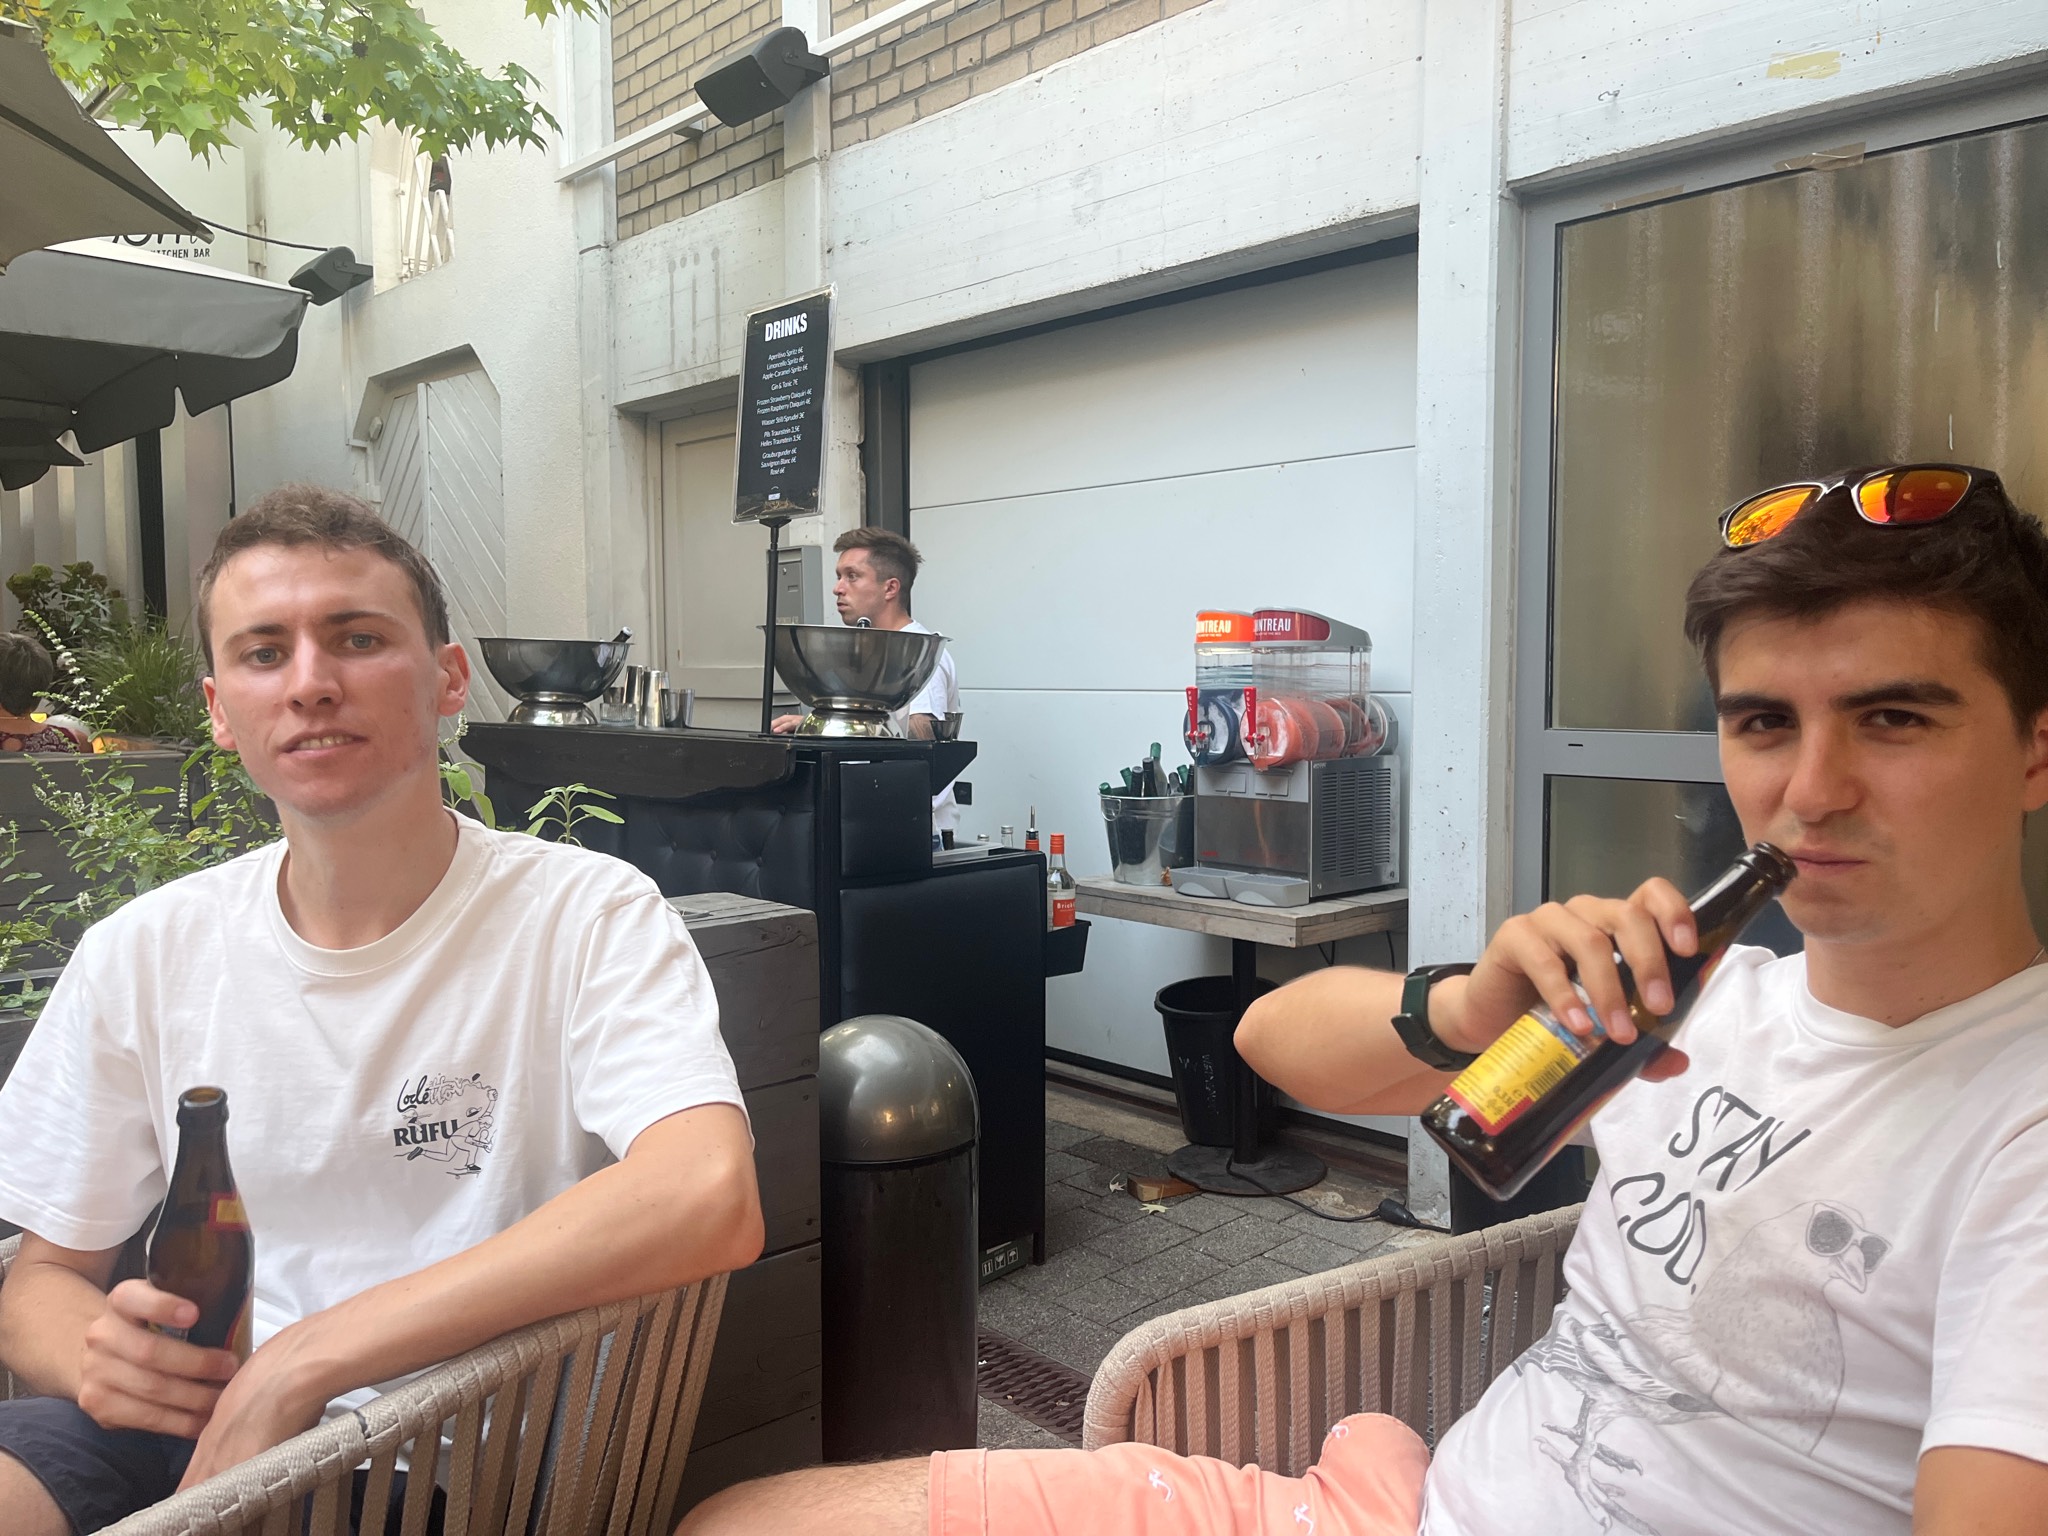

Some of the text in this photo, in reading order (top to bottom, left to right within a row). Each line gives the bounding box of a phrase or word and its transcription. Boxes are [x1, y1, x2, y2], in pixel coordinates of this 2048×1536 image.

[194, 248, 210, 258] BAR
[764, 312, 808, 342] DRINKS
[786, 348, 798, 357] Spritz
[787, 357, 799, 367] Spritz
[791, 366, 802, 374] Spritz
[782, 380, 793, 388] Tonic
[756, 397, 770, 406] Frozen
[770, 393, 790, 404] Strawberry
[790, 390, 806, 400] Daiquiri
[756, 406, 770, 415] Frozen
[770, 404, 790, 414] Raspberry
[790, 400, 805, 409] Daiquiri
[1668, 1085, 1812, 1192] STAY
